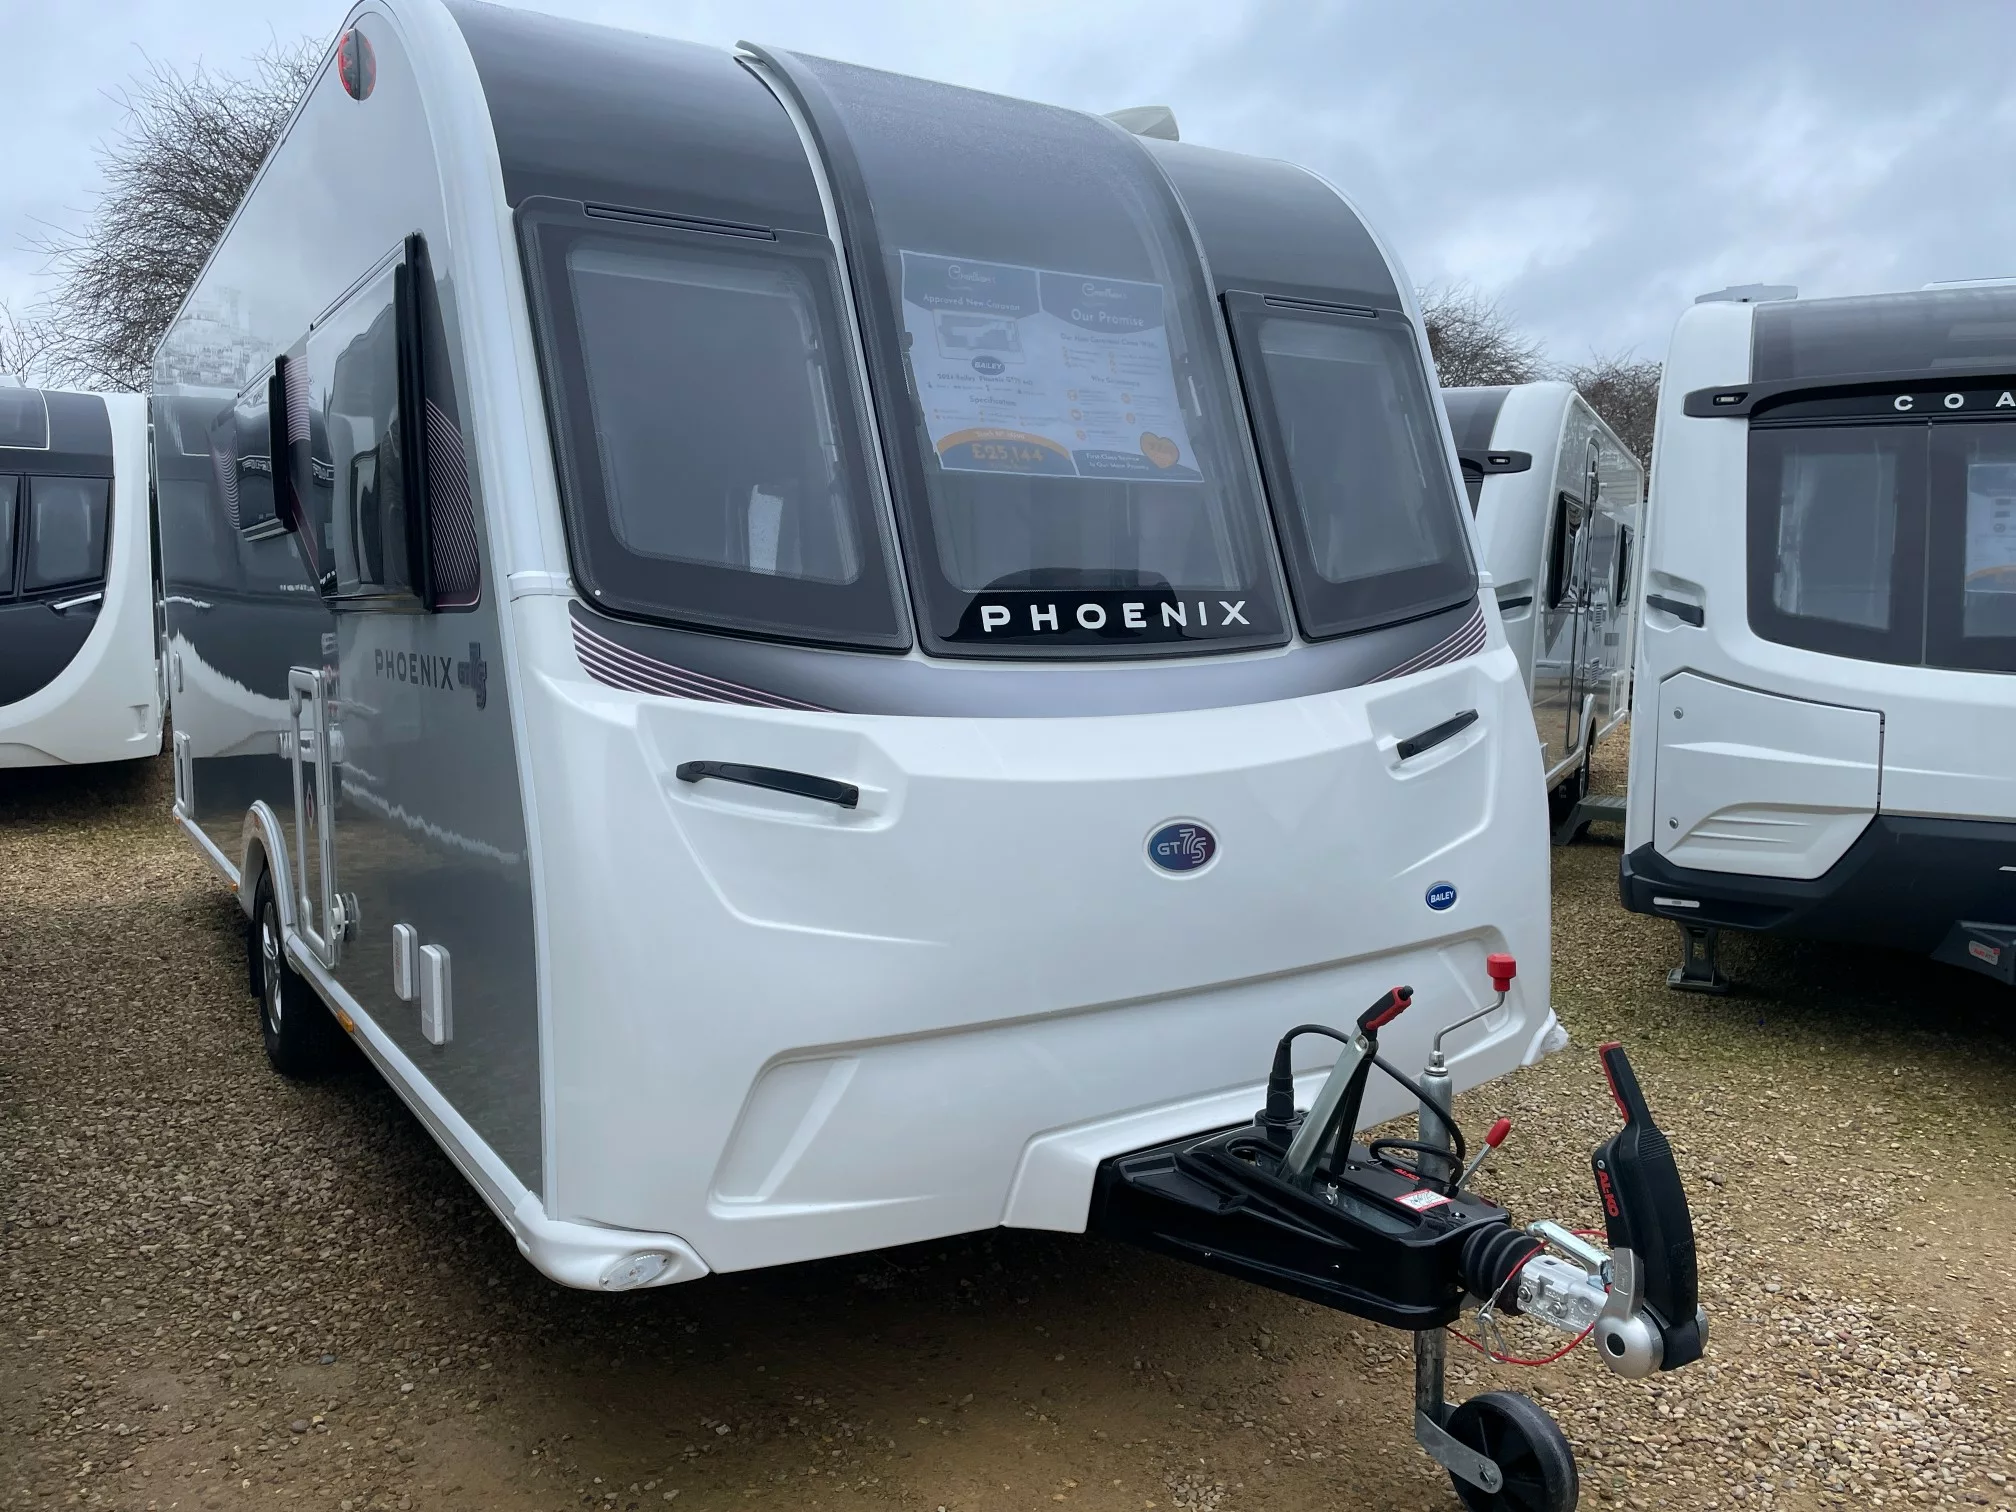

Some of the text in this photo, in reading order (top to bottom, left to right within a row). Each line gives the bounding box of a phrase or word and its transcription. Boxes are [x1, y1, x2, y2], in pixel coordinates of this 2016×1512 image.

[1071, 308, 1144, 327] Our Promise
[974, 360, 1003, 370] BAILEY
[1894, 391, 2016, 411] COA
[980, 600, 1251, 633] PHOENIX
[374, 648, 454, 691] PHOENIX
[1430, 890, 1454, 904] BAILEY
